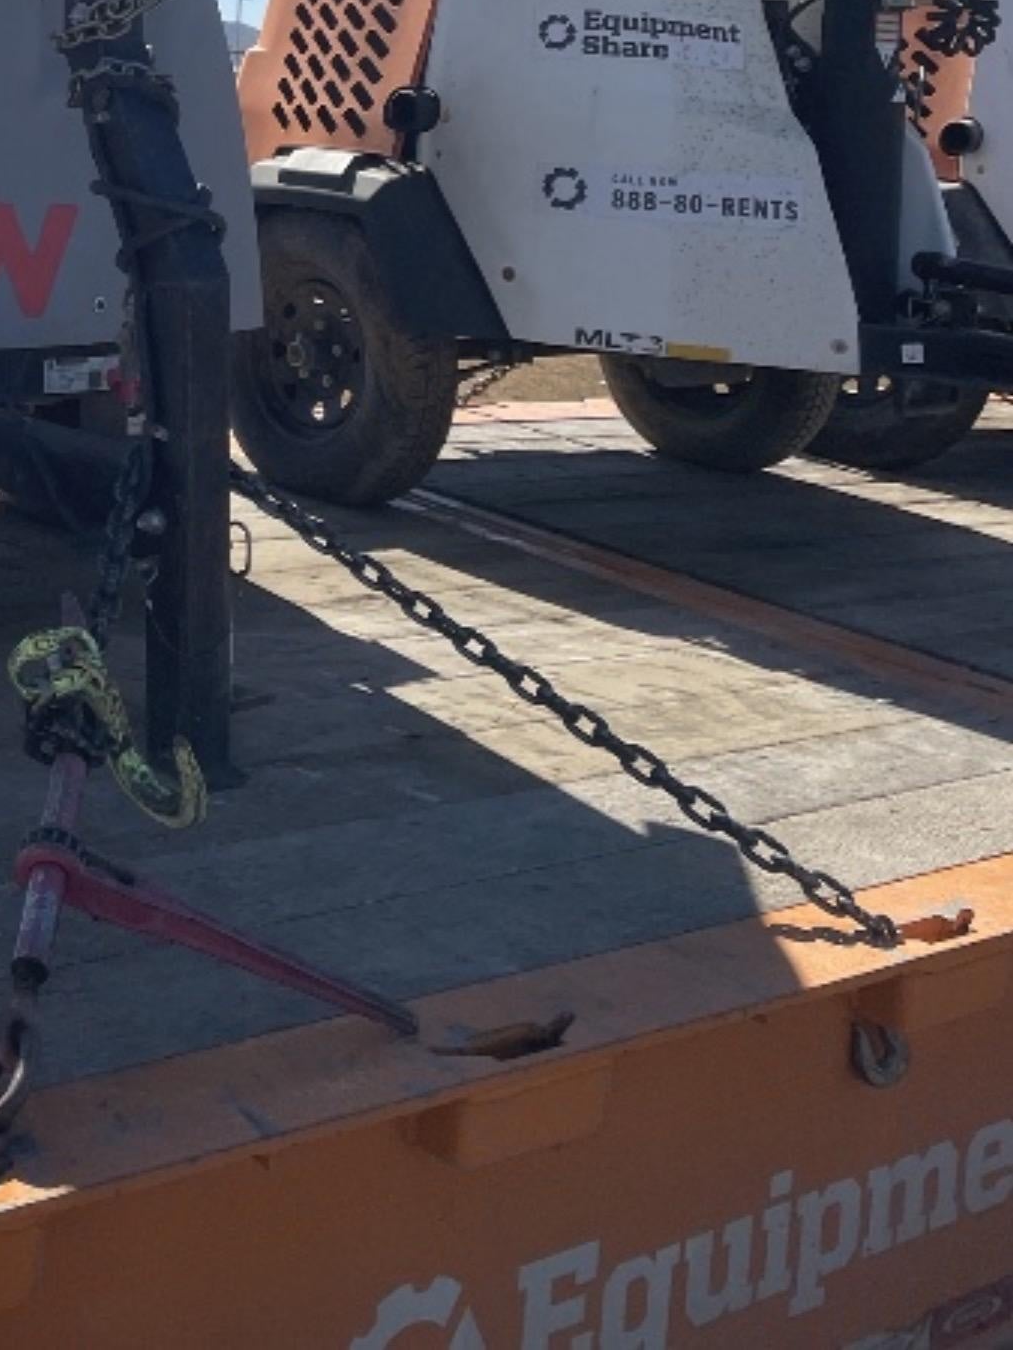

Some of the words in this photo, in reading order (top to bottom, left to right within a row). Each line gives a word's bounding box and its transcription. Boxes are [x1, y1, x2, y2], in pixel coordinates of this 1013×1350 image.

[583, 10, 741, 43] Equipment
[582, 34, 669, 60] Share
[610, 189, 799, 221] 888-80-RENTS
